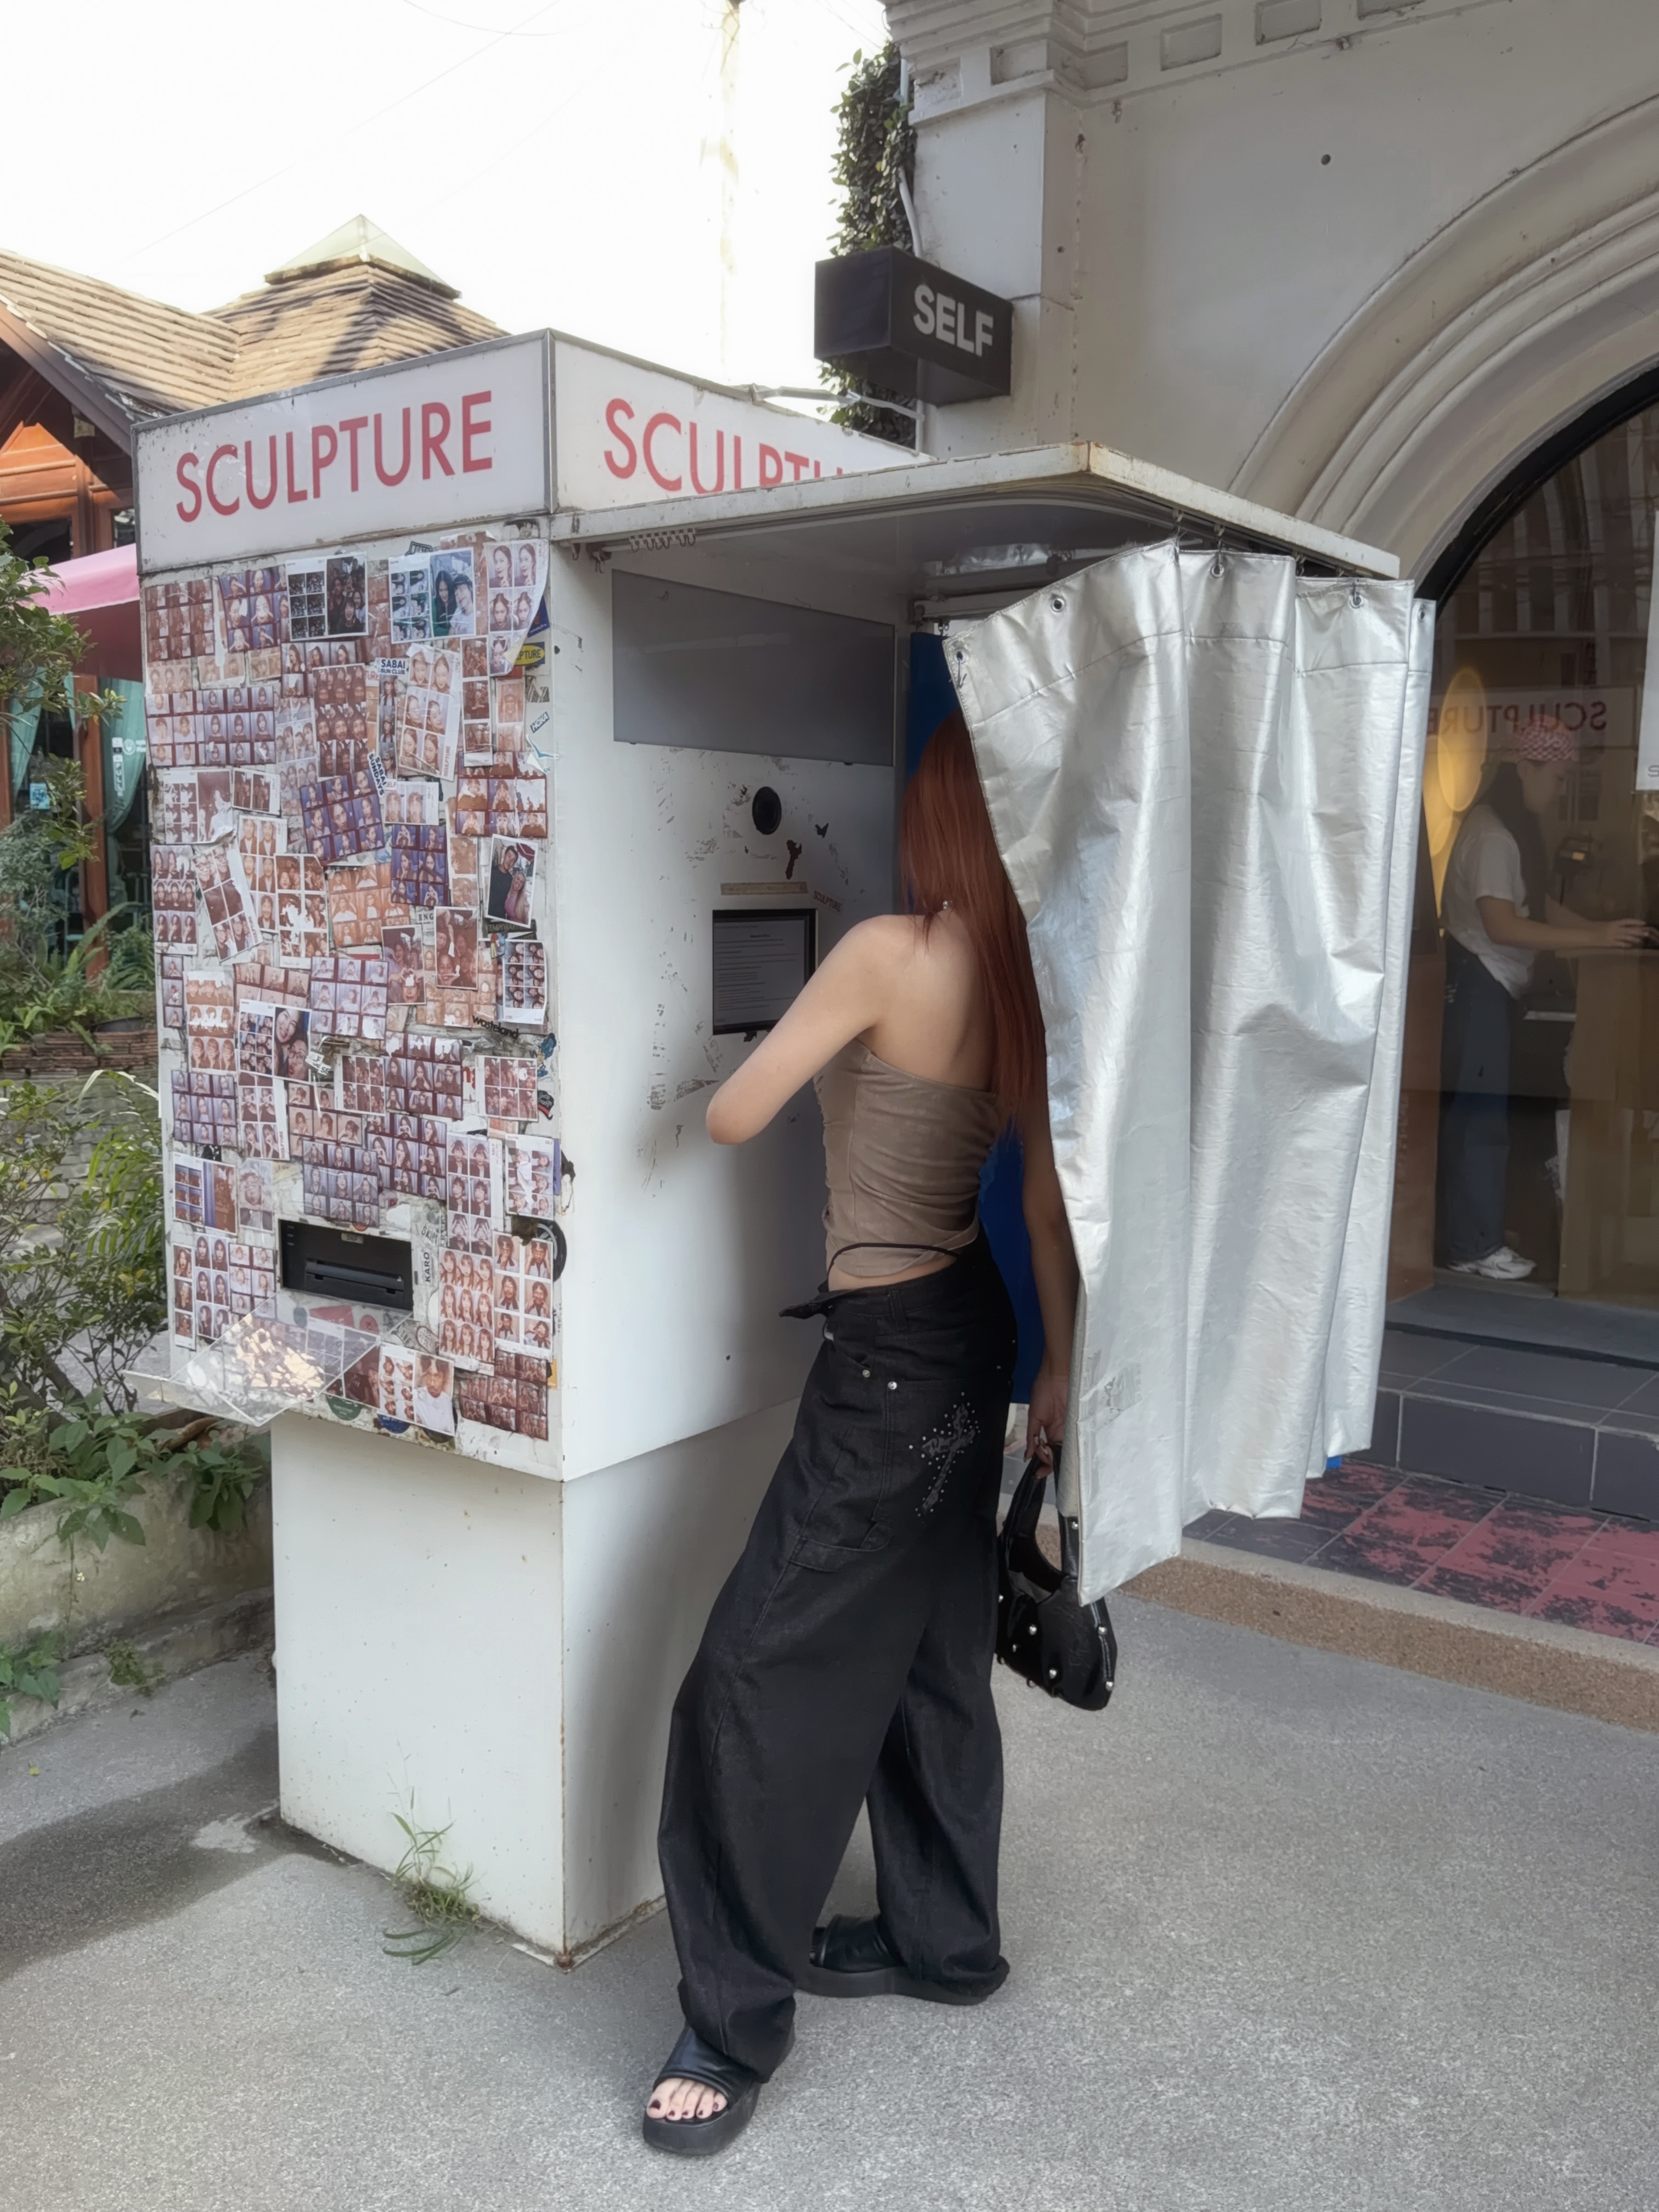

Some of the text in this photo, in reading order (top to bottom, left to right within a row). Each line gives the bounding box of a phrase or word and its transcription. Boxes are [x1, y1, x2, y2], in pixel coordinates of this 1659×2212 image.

[913, 284, 994, 357] SELF
[176, 390, 493, 523] SCULPTURE
[381, 659, 405, 669] SABAI
[532, 713, 548, 731] HOKA
[369, 754, 385, 795] SUNDAYS
[375, 757, 386, 786] SABAI
[813, 890, 842, 912] SCULPTURE
[472, 1015, 518, 1040] wasteland
